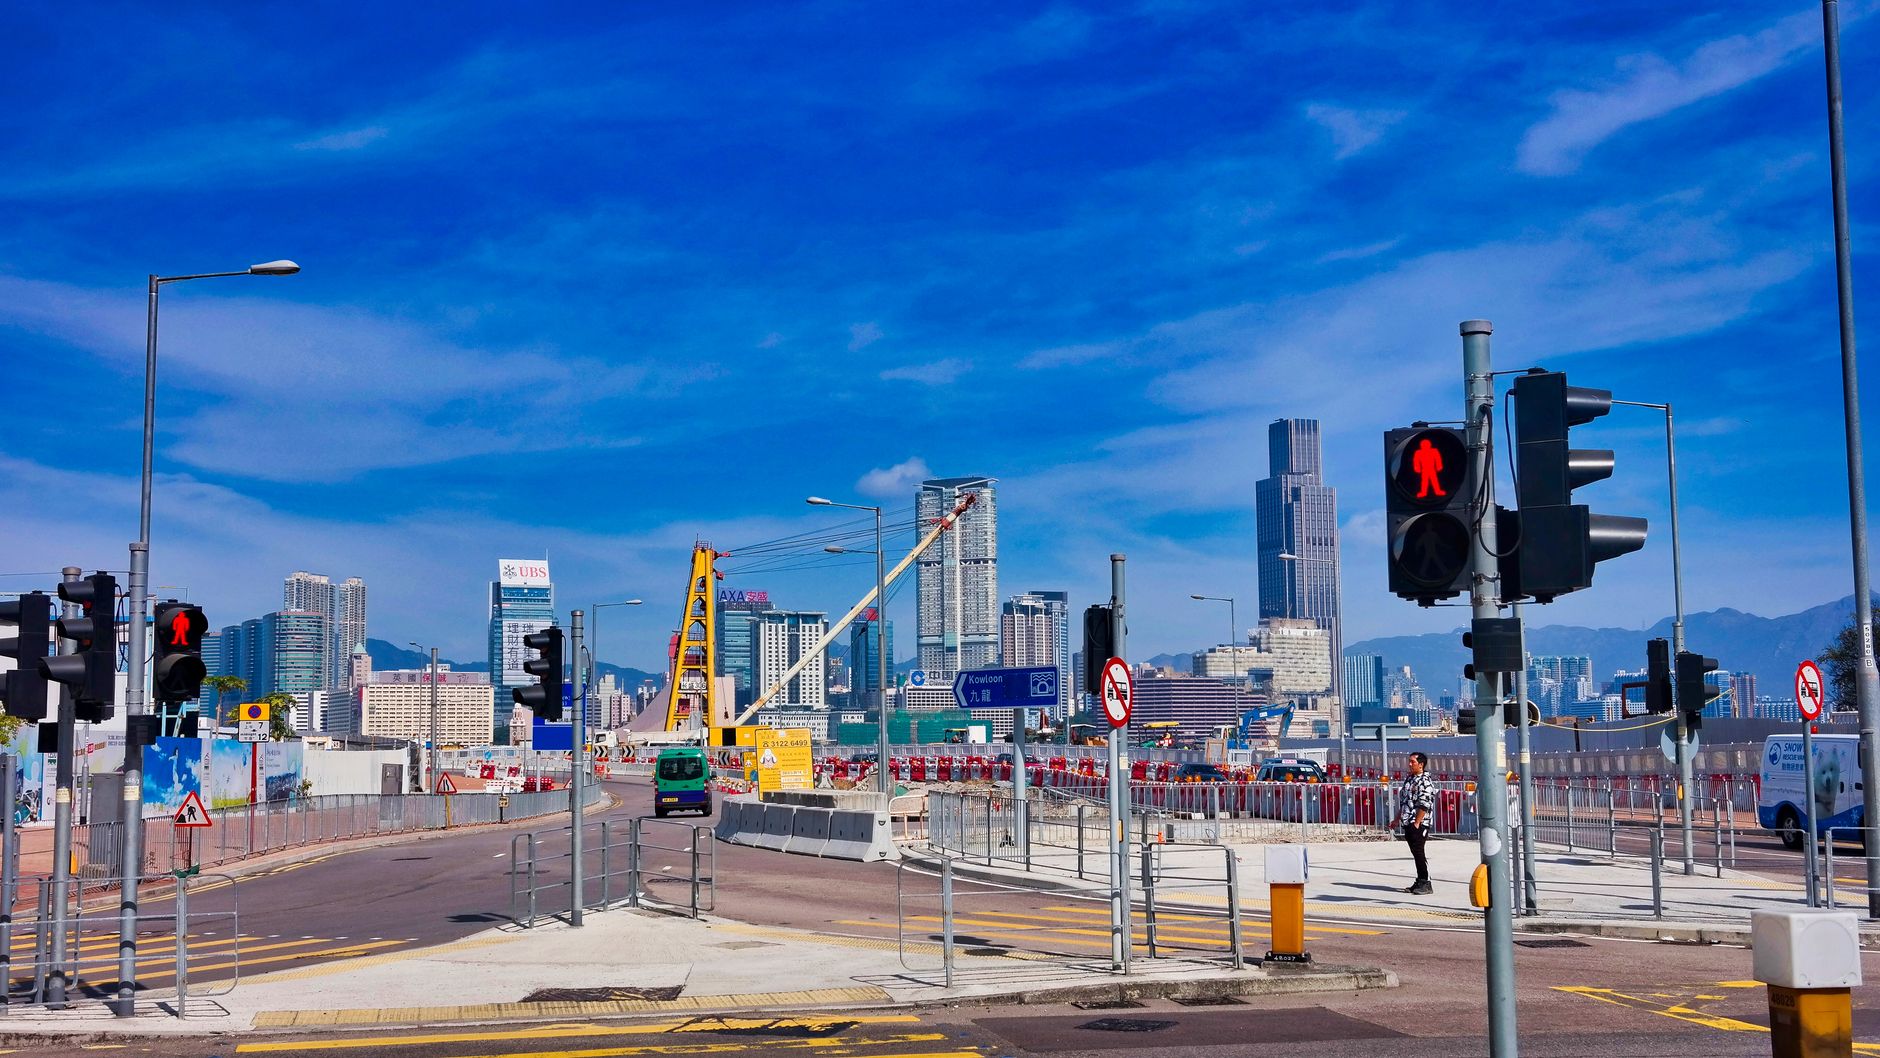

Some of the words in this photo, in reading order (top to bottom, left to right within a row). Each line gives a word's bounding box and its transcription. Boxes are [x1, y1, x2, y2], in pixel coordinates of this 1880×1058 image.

[519, 566, 547, 578] UBS
[720, 590, 745, 601] AXA
[507, 623, 519, 671] 理財有道
[968, 674, 1003, 684] Kowloon
[970, 689, 992, 703] 九龍
